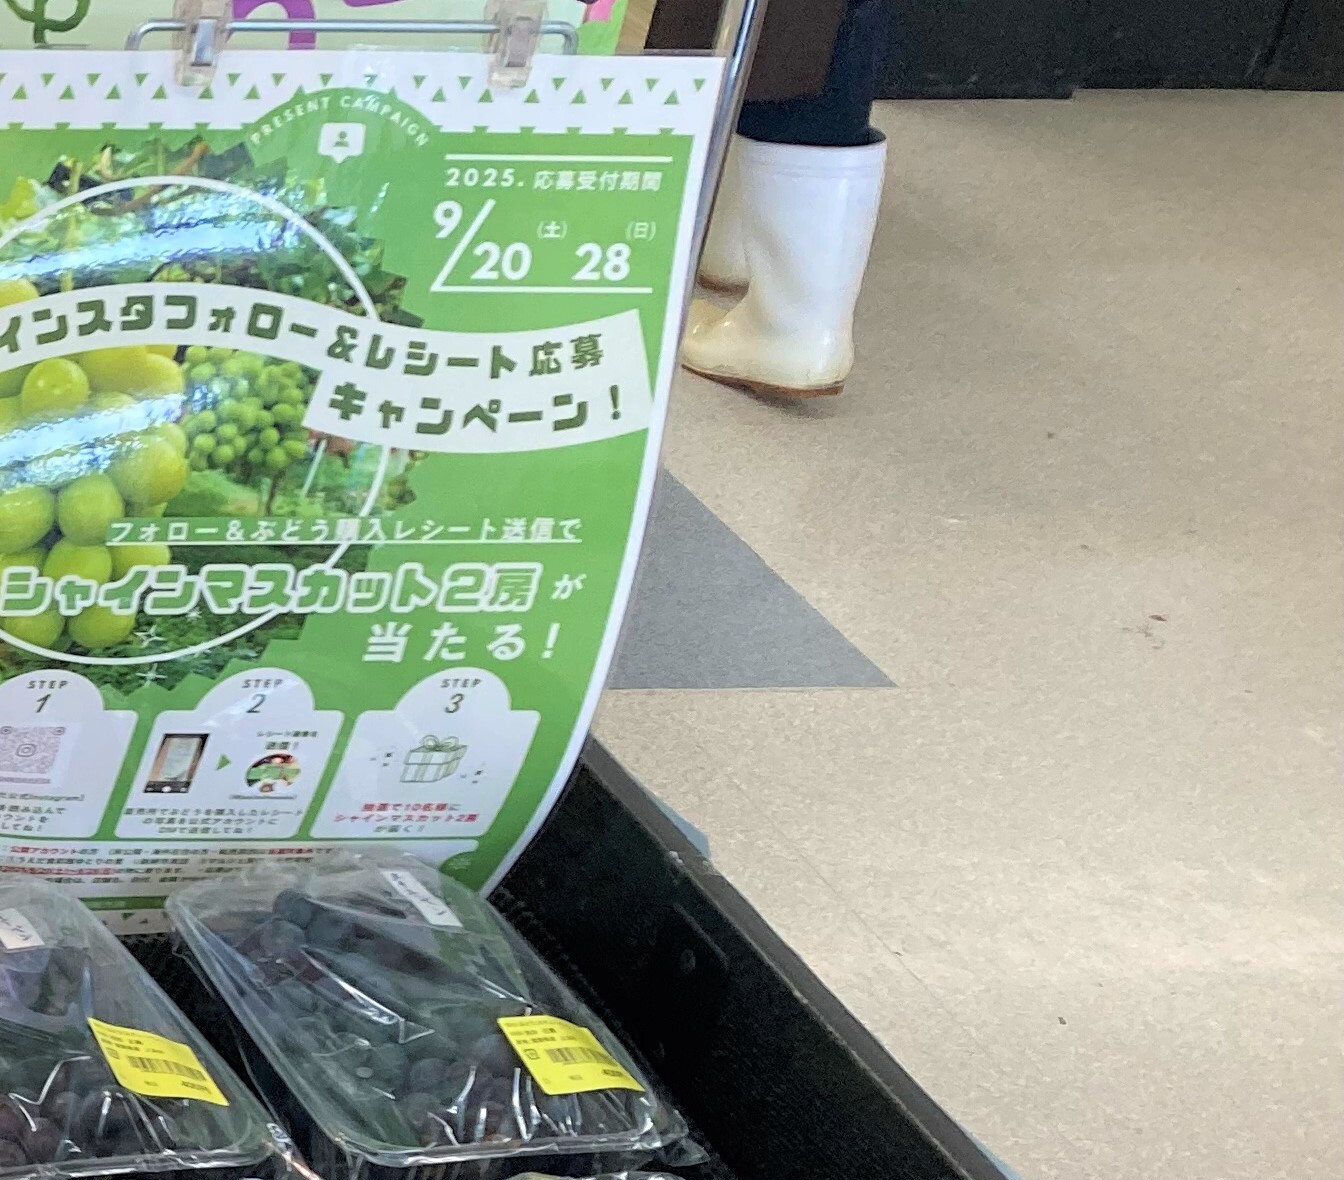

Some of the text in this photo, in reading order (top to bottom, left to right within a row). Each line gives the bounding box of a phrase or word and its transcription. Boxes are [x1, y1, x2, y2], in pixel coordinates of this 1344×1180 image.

[250, 94, 429, 147] PRESENT CAMPAIGN
[445, 168, 662, 191] 2025. 応募受付期間
[433, 201, 463, 239] 9
[471, 242, 631, 281] 20 28
[329, 383, 624, 438] キャンペーン!
[363, 623, 558, 663] 当たる!
[27, 680, 68, 689] STEP
[242, 679, 283, 688] STEP
[440, 679, 482, 688] STEP
[35, 694, 51, 713] 1
[247, 694, 266, 713] 2
[444, 694, 465, 713] 3
